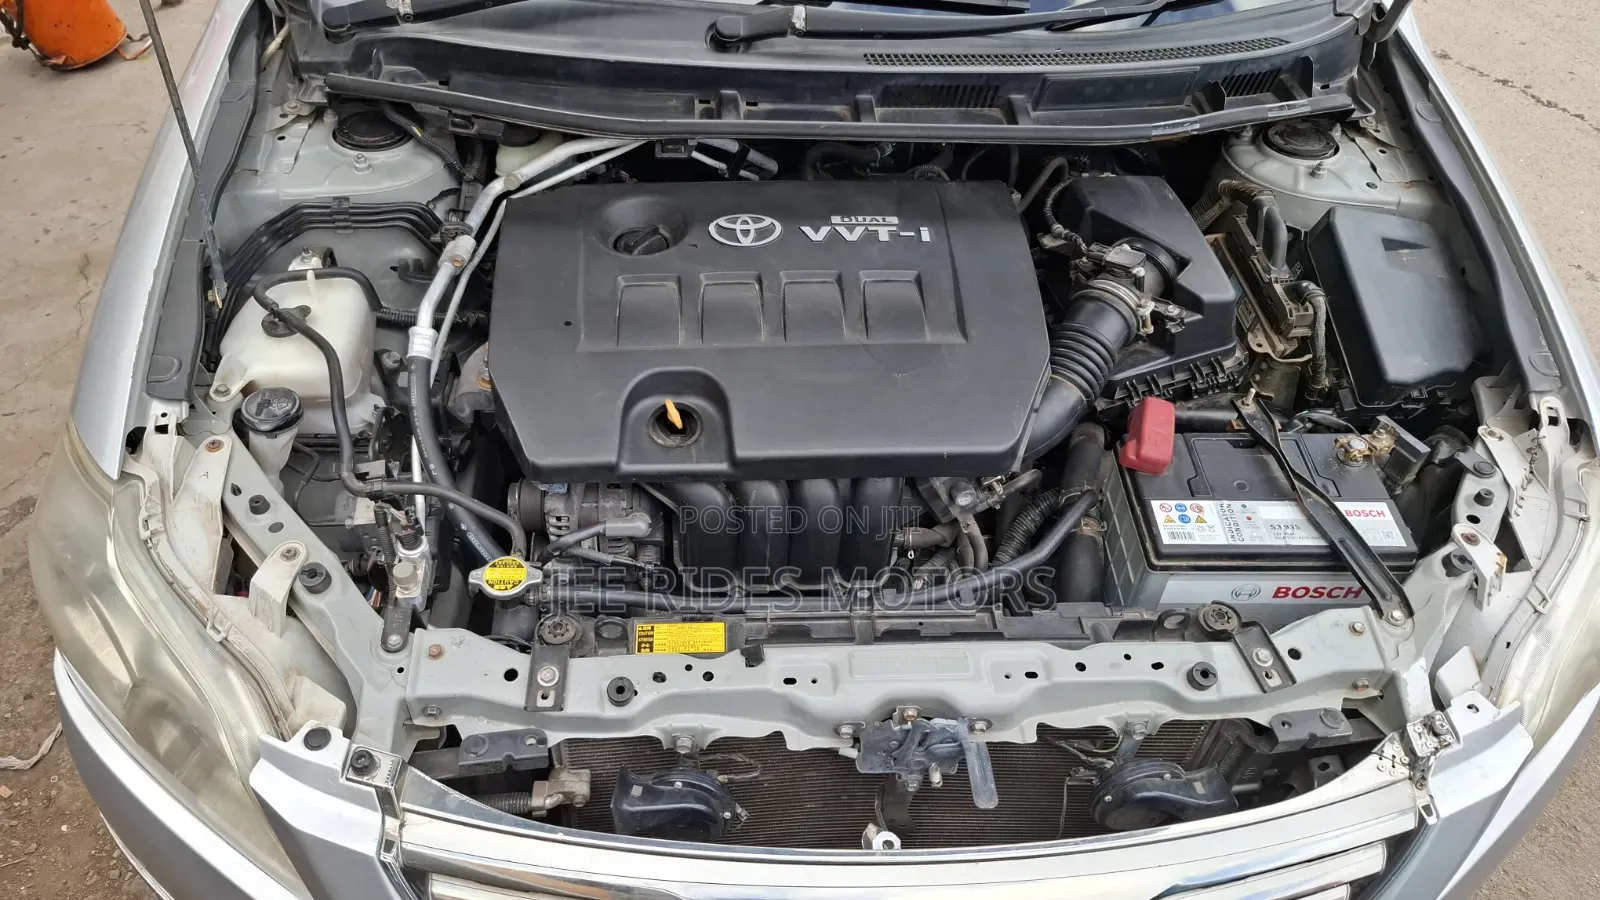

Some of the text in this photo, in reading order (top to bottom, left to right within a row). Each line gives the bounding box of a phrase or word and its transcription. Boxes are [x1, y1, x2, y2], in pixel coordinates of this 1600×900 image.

[838, 215, 894, 224] DUAL
[1344, 509, 1386, 518] BOSCH
[1226, 503, 1245, 542] CONDITION
[1271, 586, 1364, 599] BOSCH
